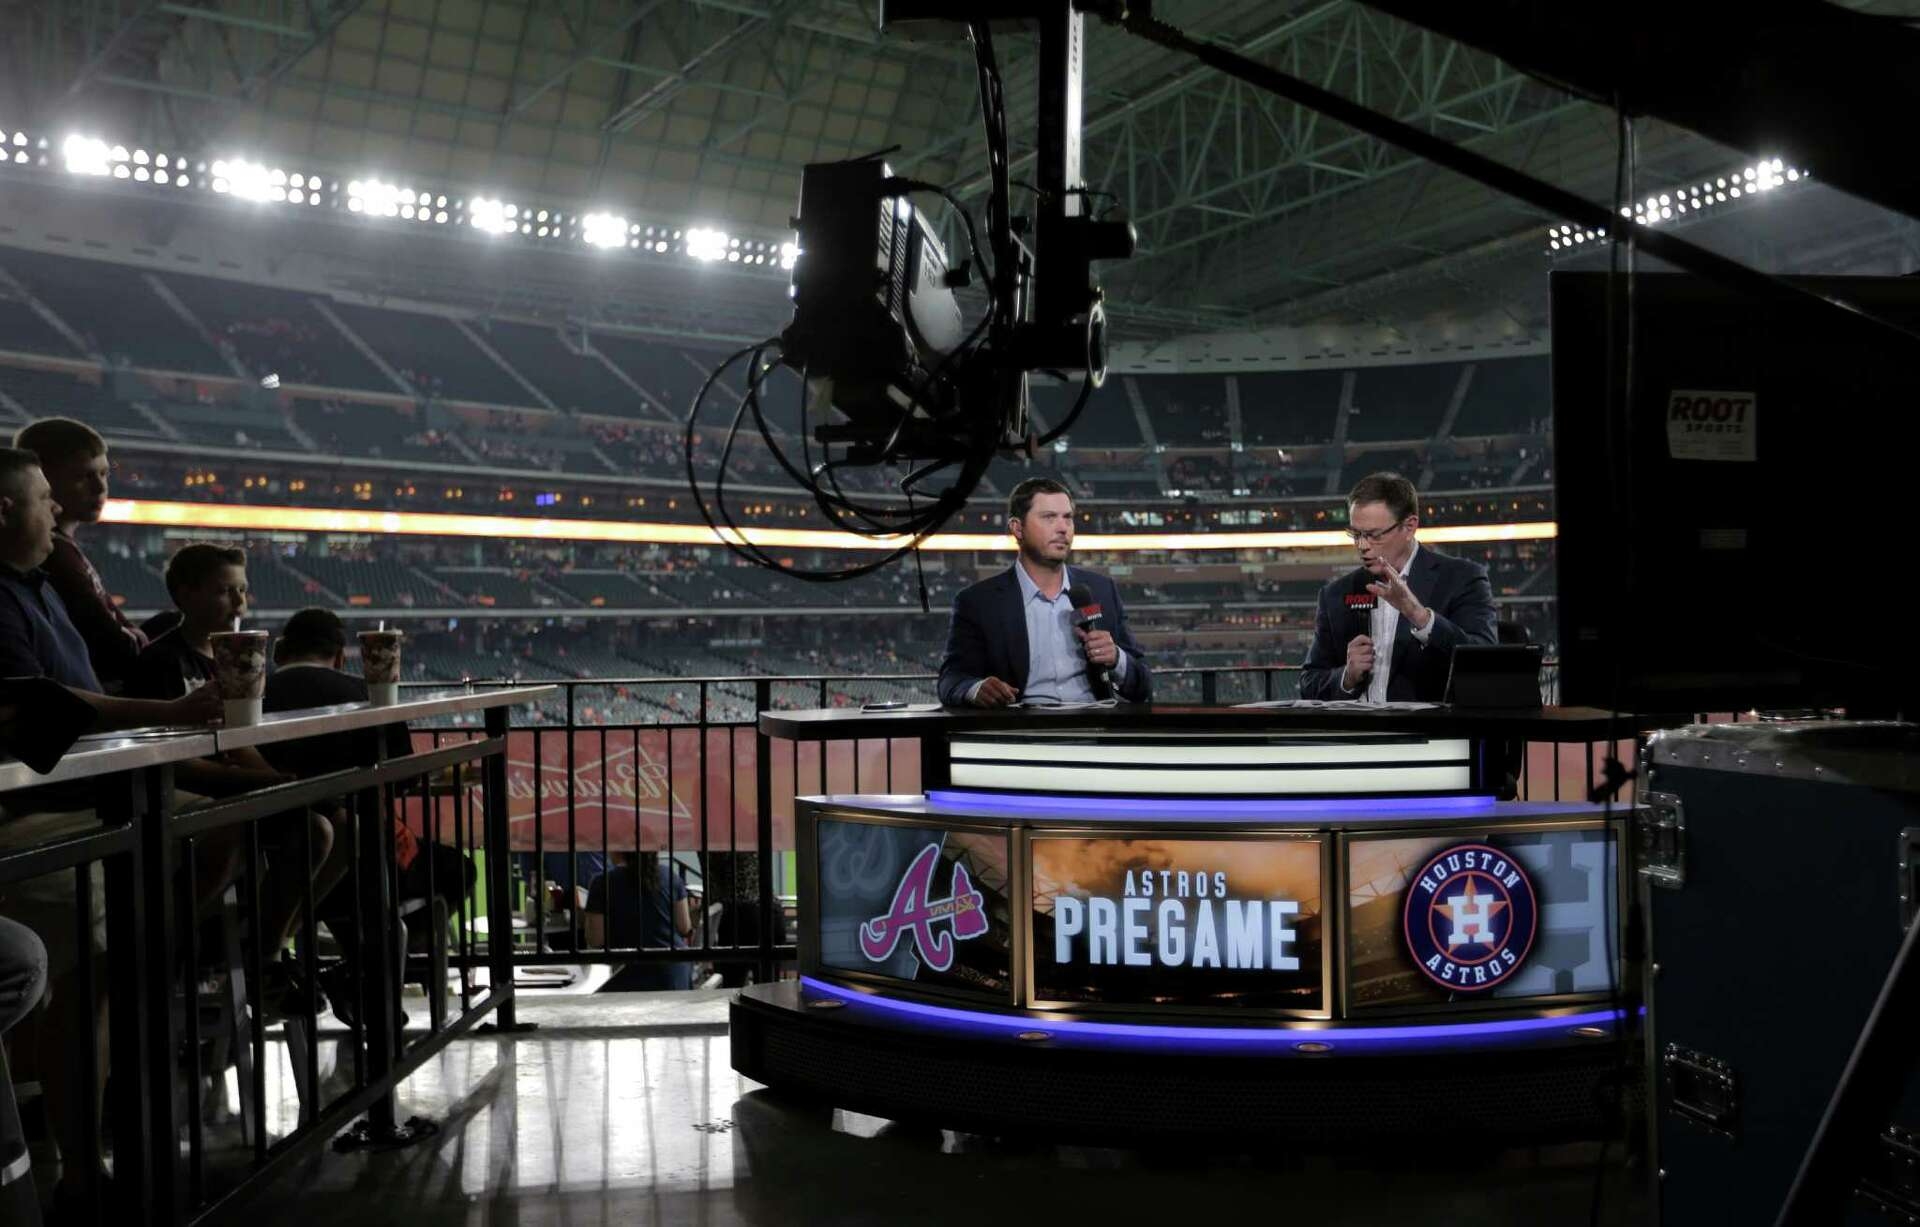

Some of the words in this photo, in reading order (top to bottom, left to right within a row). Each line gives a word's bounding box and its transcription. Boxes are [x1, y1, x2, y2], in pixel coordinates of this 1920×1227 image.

[1670, 396, 1752, 423] ROOT
[1685, 423, 1744, 434] SPORTS
[1124, 870, 1227, 898] ASTROS
[1420, 851, 1521, 894] HOUSTON
[1055, 896, 1300, 970] PREGAME
[1447, 894, 1494, 945] H
[1426, 948, 1516, 984] ASTROS
